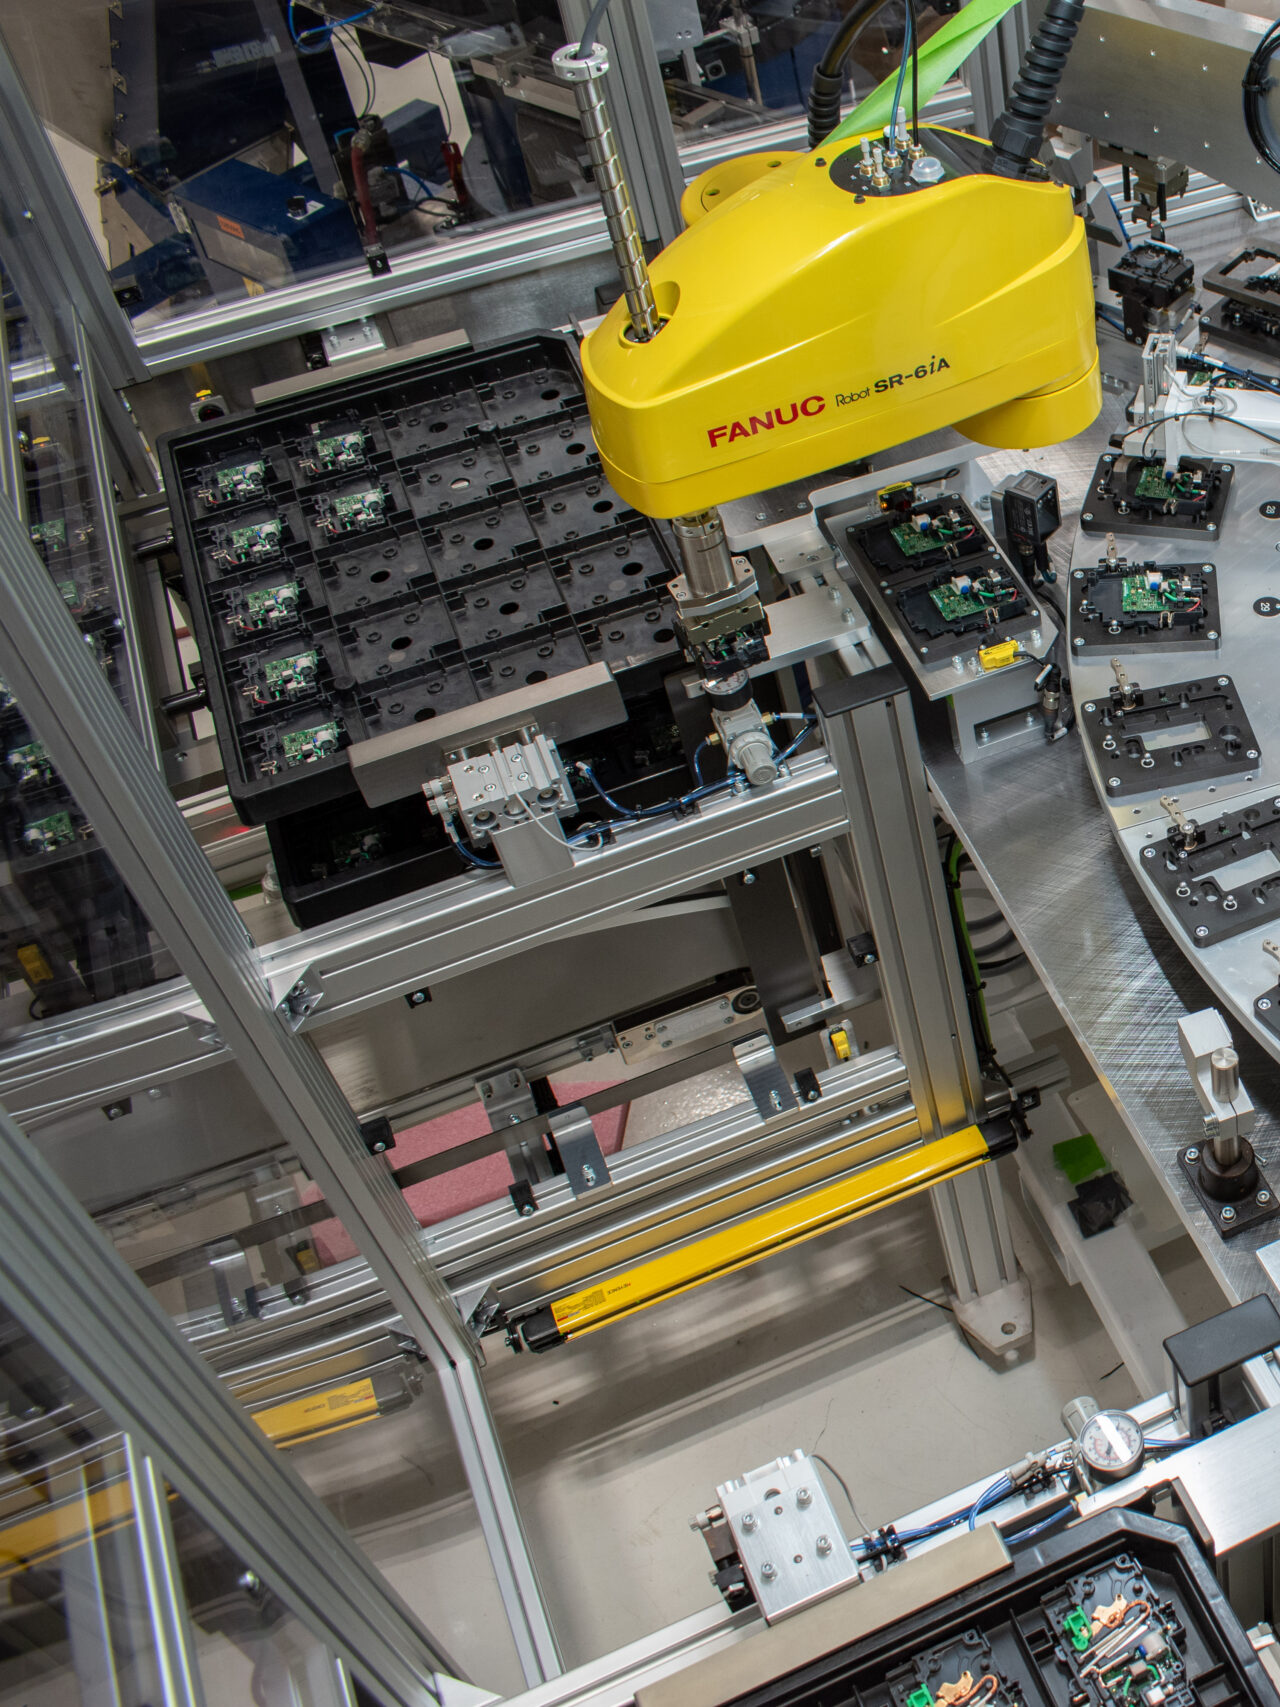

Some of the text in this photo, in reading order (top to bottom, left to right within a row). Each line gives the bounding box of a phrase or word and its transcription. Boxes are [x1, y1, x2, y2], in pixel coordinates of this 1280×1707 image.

[707, 355, 951, 448] FANUC Robot SR-6iA
[1265, 505, 1276, 515] 28
[1260, 602, 1271, 612] 29
